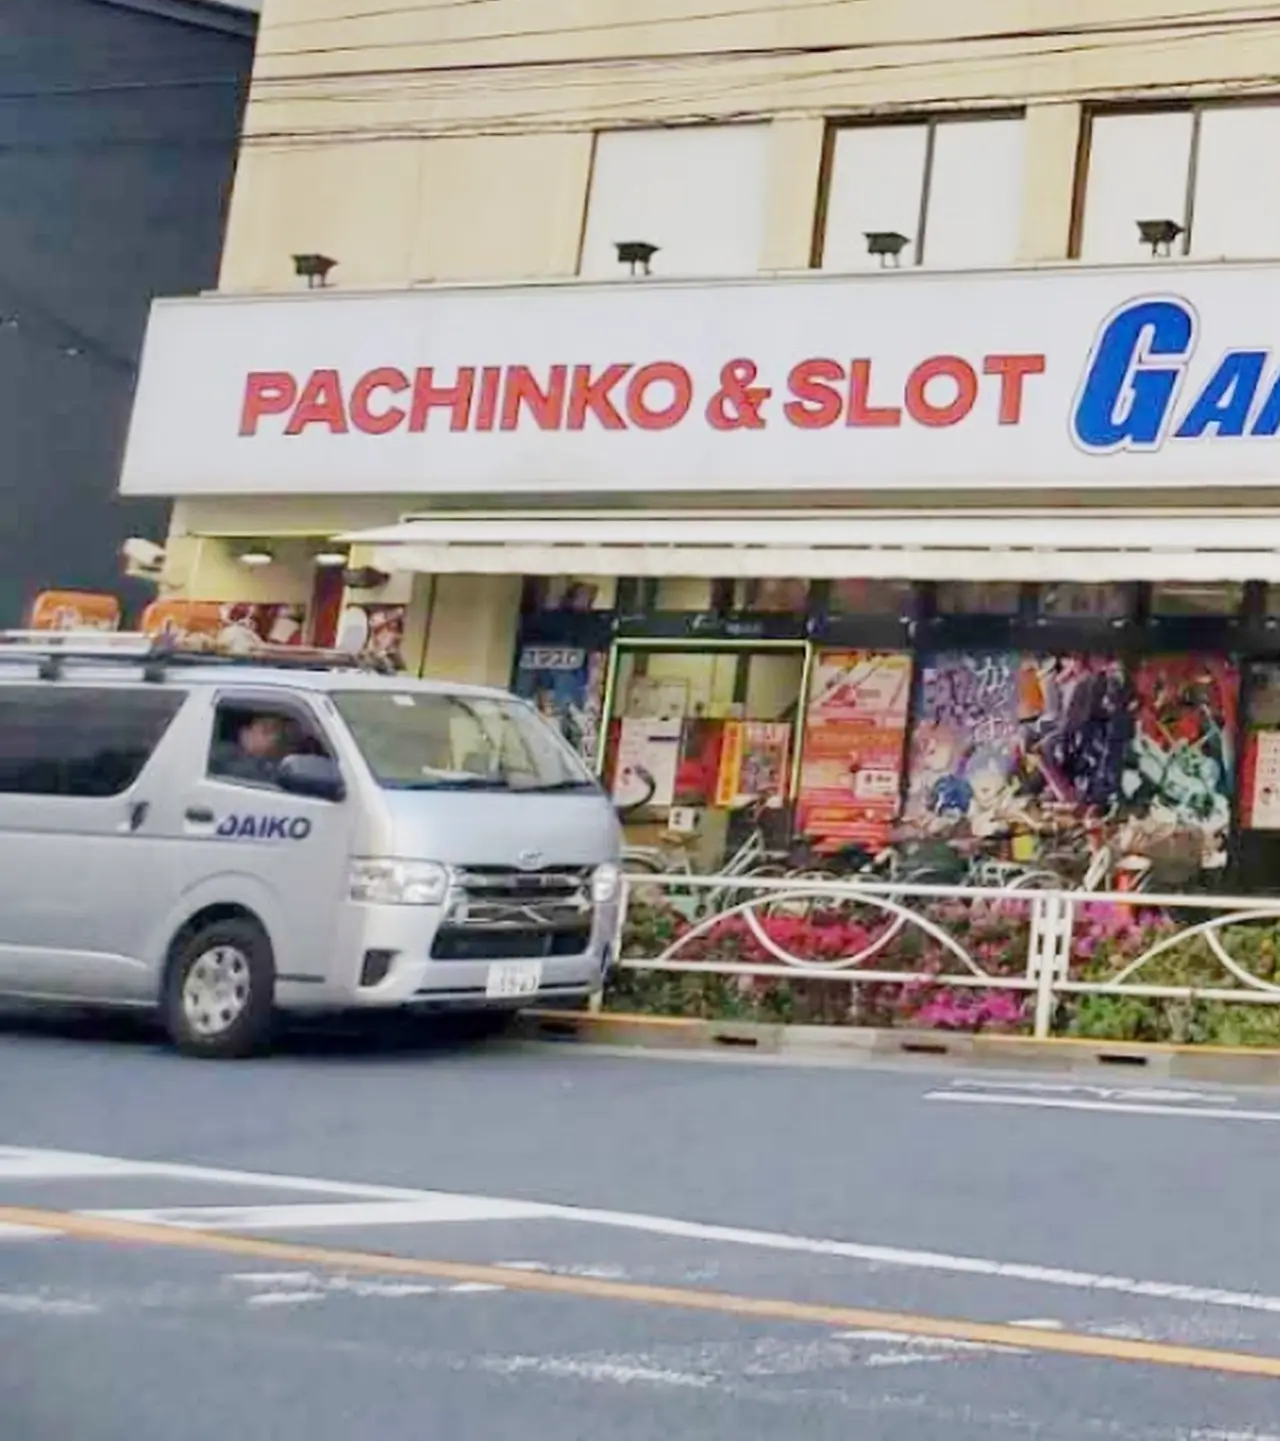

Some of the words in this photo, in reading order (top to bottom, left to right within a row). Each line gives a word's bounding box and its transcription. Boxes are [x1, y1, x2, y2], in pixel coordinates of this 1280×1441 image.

[238, 359, 692, 437] PACHINKO
[705, 358, 773, 431] &
[783, 353, 1046, 430] SLOT
[216, 813, 312, 840] DAIKO
